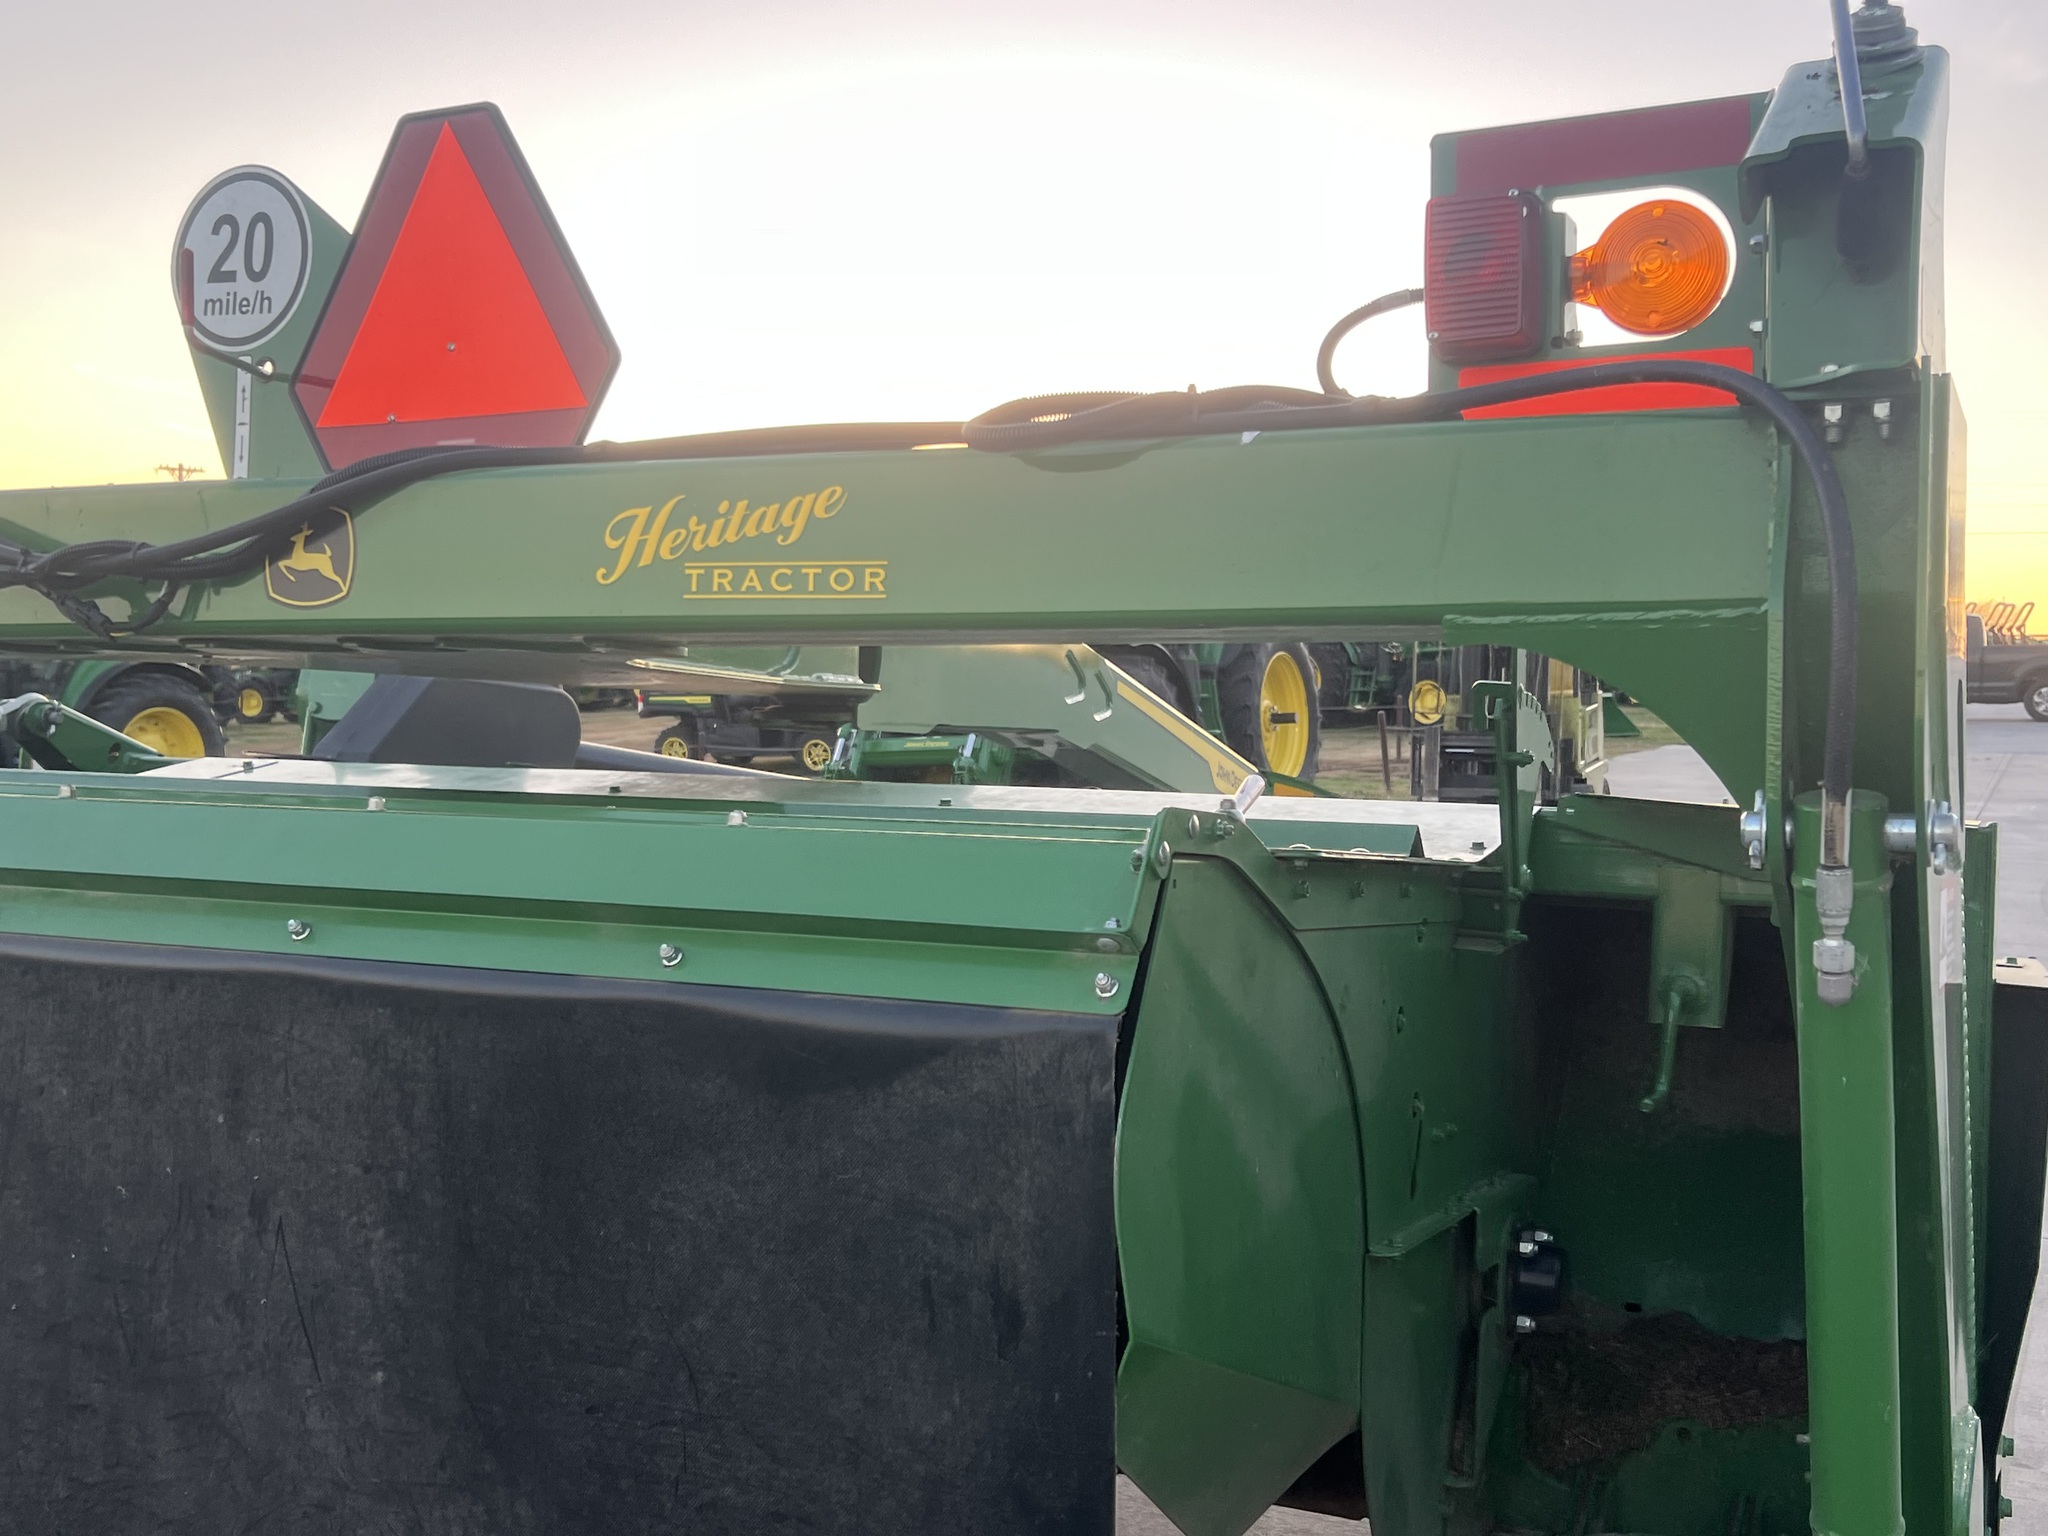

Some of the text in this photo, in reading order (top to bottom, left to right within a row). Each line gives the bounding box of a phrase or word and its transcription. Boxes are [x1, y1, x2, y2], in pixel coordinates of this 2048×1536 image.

[208, 211, 274, 283] 20
[203, 291, 272, 316] mile/h
[596, 486, 848, 585] Heritage
[685, 568, 886, 592] TRACTOR
